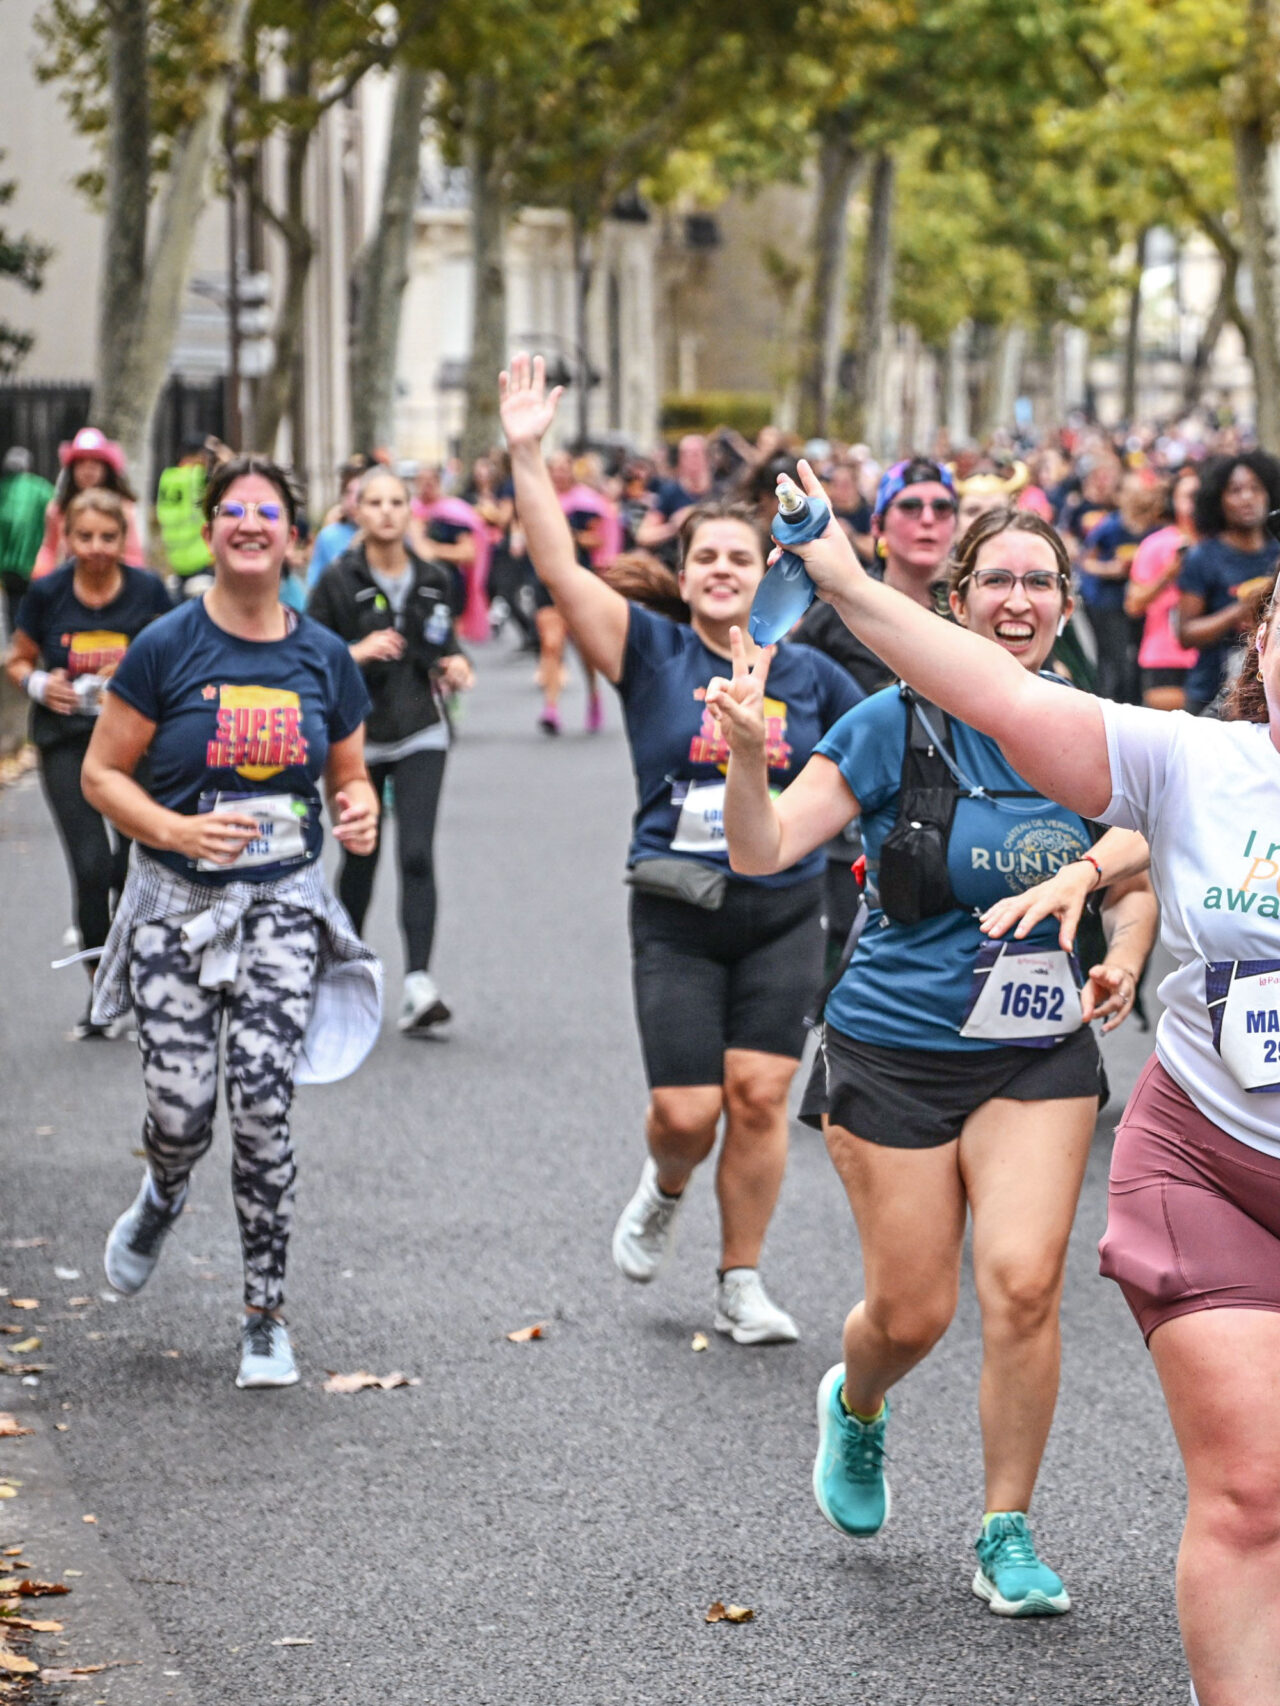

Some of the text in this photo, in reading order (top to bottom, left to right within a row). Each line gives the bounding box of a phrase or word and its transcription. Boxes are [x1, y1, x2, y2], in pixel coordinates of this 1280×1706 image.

[216, 707, 301, 739] SUPER
[206, 736, 308, 767] HEROINES
[1243, 830, 1257, 858] I
[1000, 981, 1064, 1022] 1652
